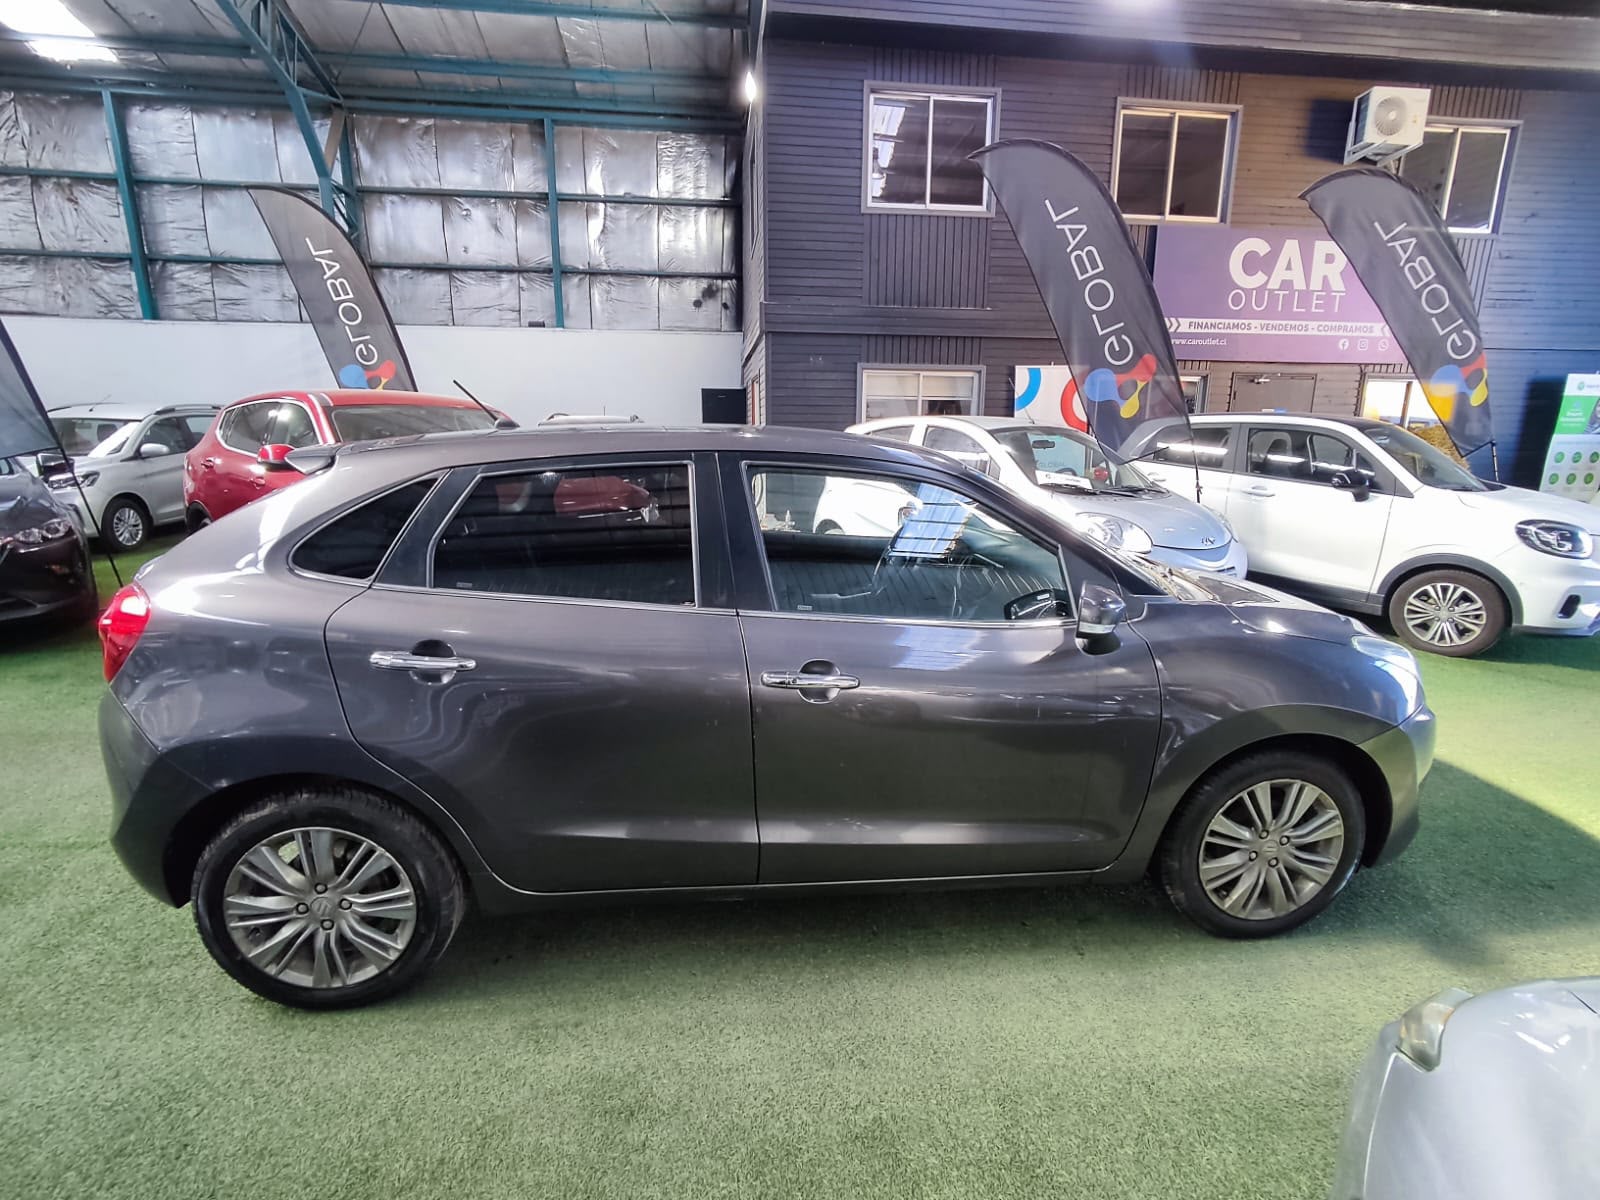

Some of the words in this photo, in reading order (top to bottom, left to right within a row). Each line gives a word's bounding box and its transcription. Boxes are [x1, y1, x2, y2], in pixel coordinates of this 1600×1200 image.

[1229, 237, 1347, 291] CAR
[1228, 289, 1346, 313] OUTLET
[1188, 321, 1252, 331] FINANCIAMOS
[1260, 323, 1309, 332] VENDEMOS
[1316, 324, 1374, 334] COMPRAMOS
